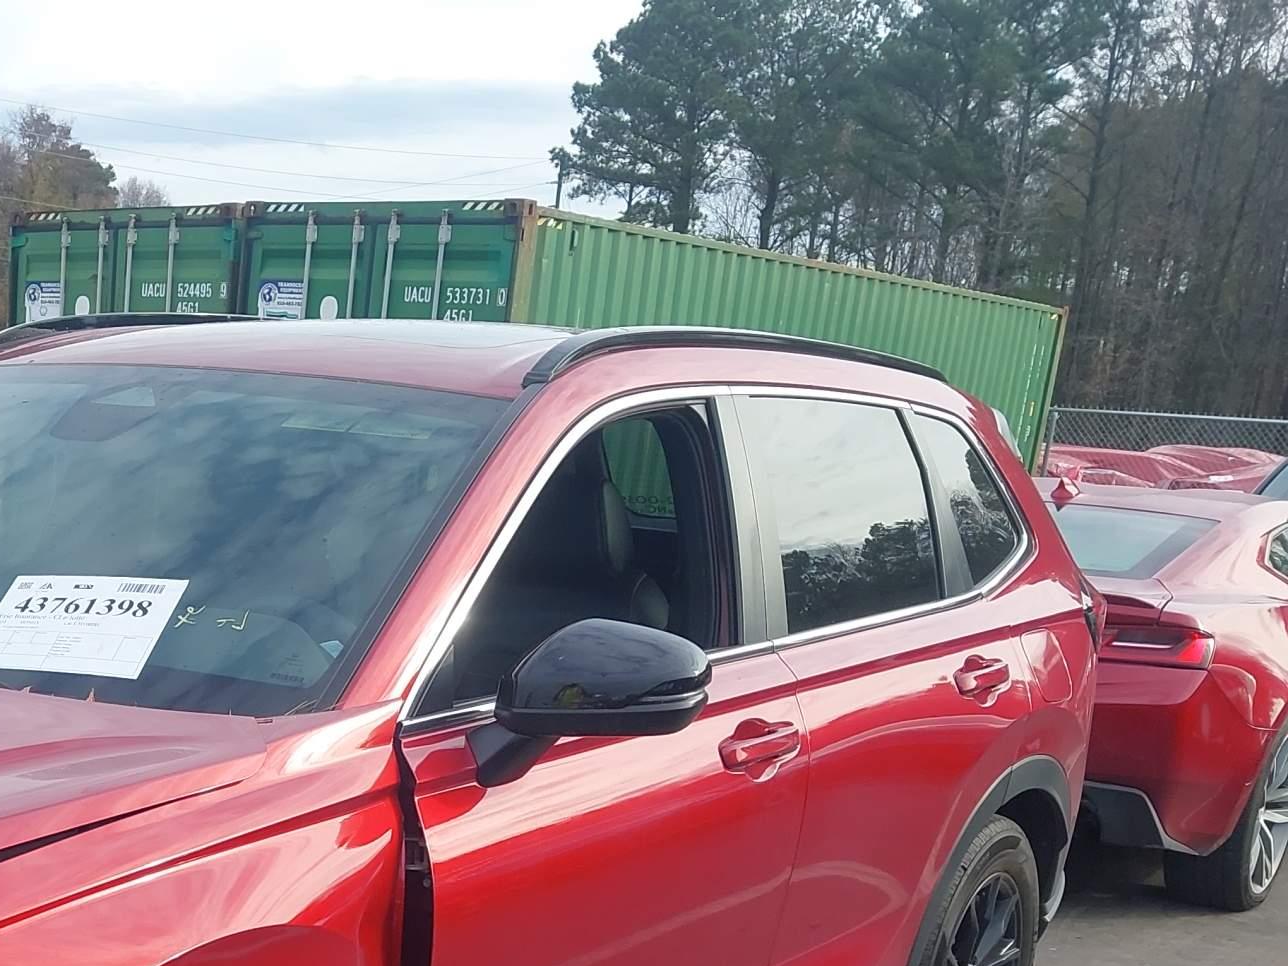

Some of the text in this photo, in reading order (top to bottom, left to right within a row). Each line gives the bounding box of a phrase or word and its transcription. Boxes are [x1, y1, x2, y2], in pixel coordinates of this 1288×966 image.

[141, 282, 227, 298] UACU 524495 9
[404, 286, 506, 306] UACU 533731 0
[176, 302, 200, 313] 45G1
[443, 309, 473, 322] 45G1
[14, 596, 153, 618] 43761398
